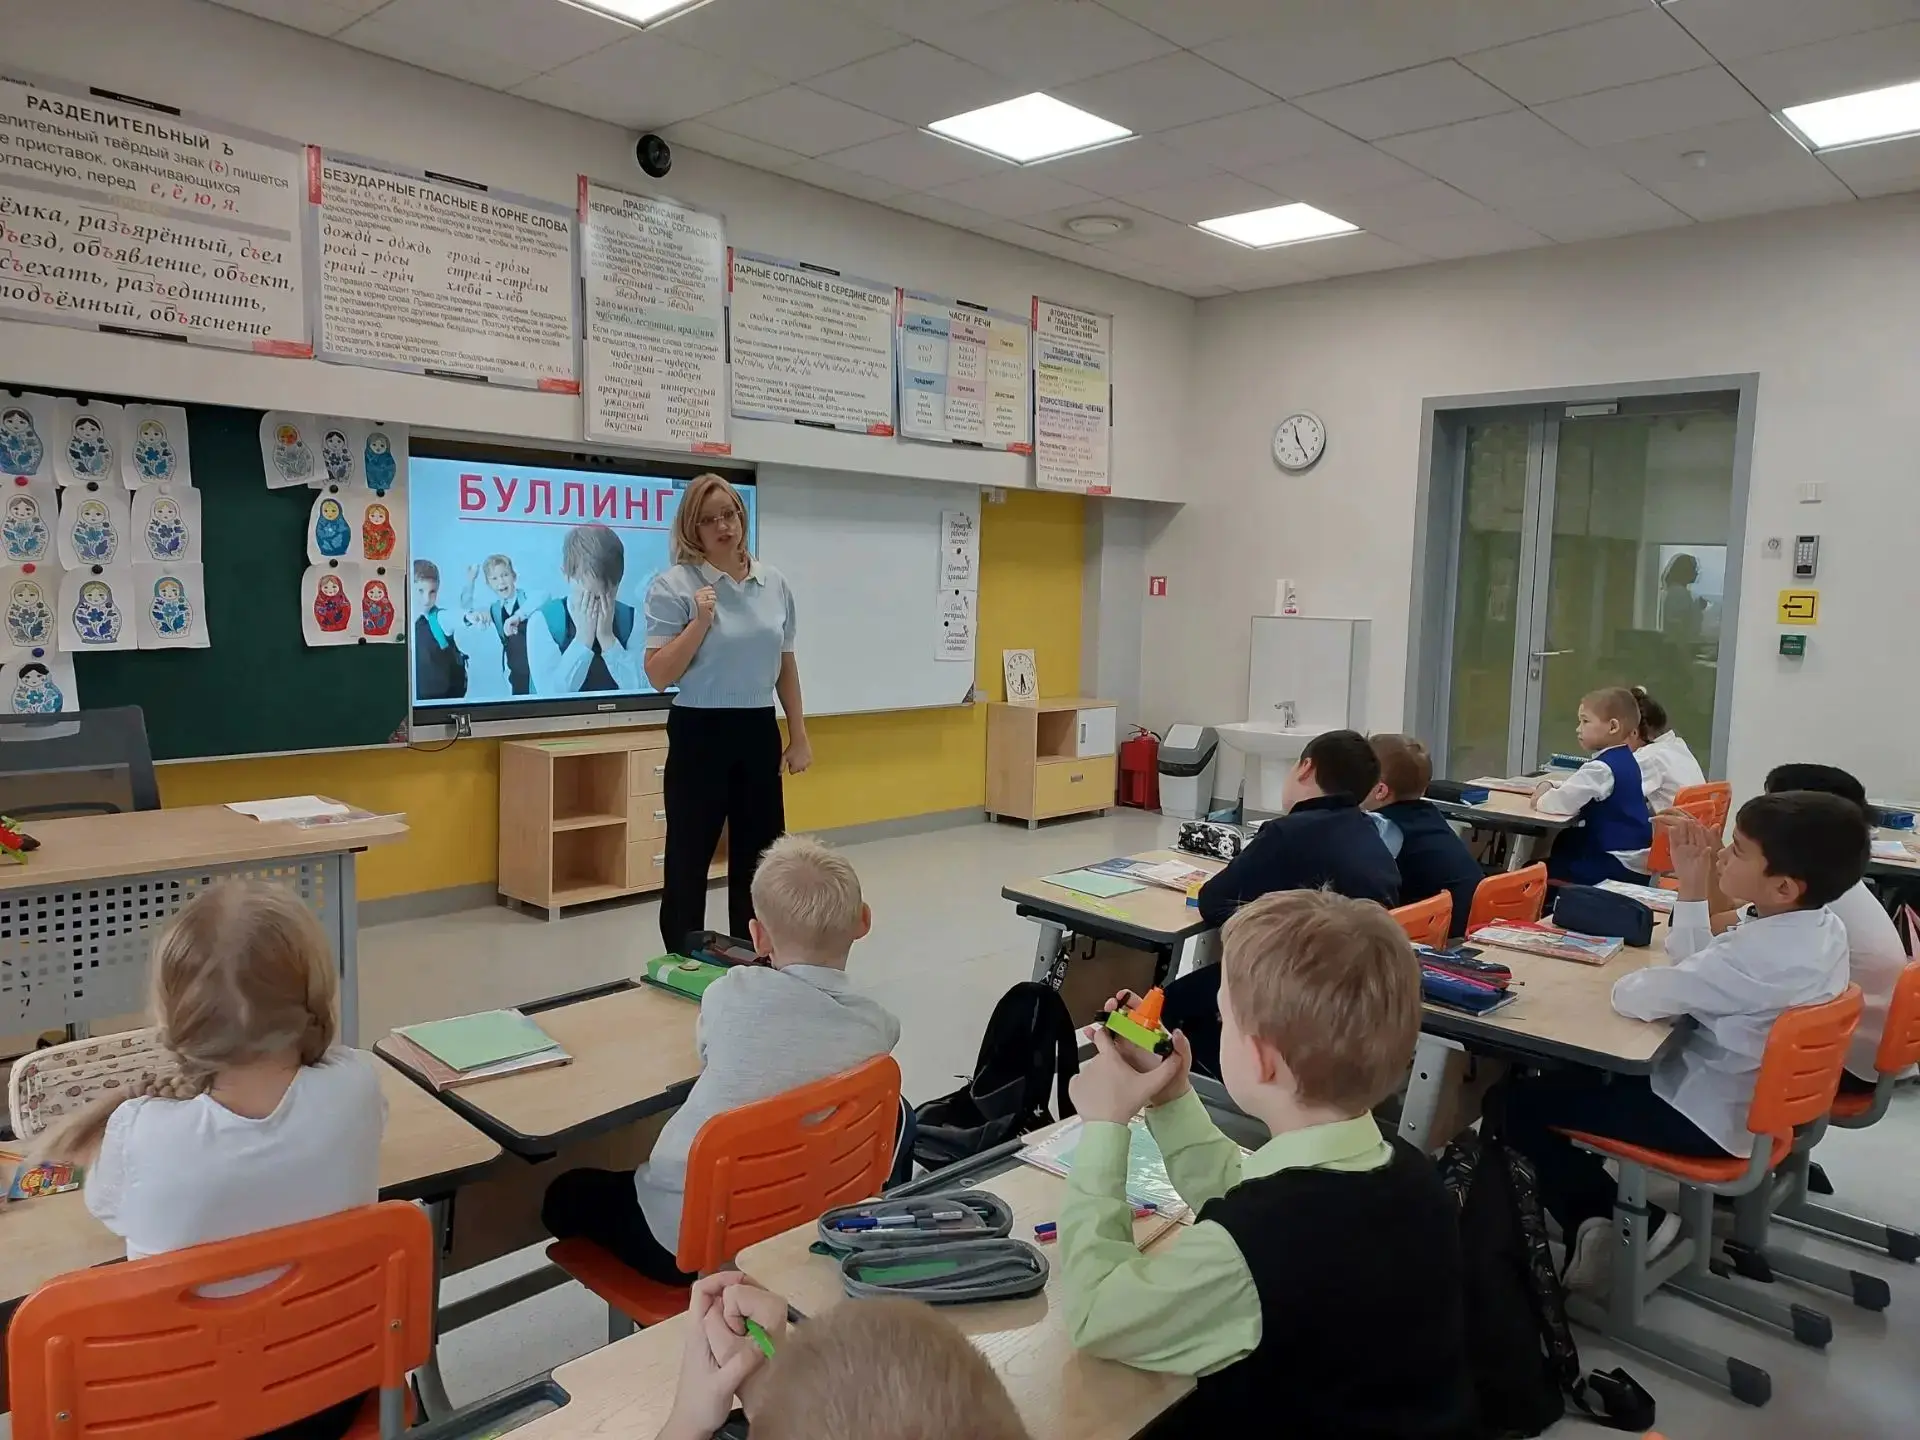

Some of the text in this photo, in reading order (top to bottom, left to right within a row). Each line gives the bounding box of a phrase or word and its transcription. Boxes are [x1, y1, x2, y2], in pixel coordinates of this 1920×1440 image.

[26, 93, 209, 151] РАЗДЕЛИТЕЛЬНЫЙ
[87, 171, 136, 192] перед
[103, 132, 168, 162] твёрдый
[173, 151, 204, 168] знак
[232, 165, 288, 189] пишется
[112, 156, 240, 196] оканчивающихся
[323, 165, 415, 199] БЕЗУДАРНЫЕ
[419, 188, 477, 212] ГЛАСНЫЕ
[481, 203, 488, 214] В
[491, 205, 528, 223] КОРНЕ
[531, 214, 567, 233] СЛОВА
[78, 210, 232, 259] разъярённый,
[240, 244, 281, 265] съел
[648, 225, 673, 239] КОРНЕ
[73, 235, 206, 278] объявление,
[213, 260, 294, 293] объект,
[734, 262, 770, 279] ПАРНЫЕ
[773, 270, 822, 291] СОГЛАСНЫЕ
[825, 282, 828, 290] В
[831, 284, 866, 302] СЕРЕДИНЕ
[867, 293, 889, 306] СЛОВА
[116, 272, 266, 314] разъединить,
[150, 303, 271, 338] объяснение
[974, 316, 991, 329] РЕЧИ
[460, 473, 674, 521] БУЛЛИНГ
